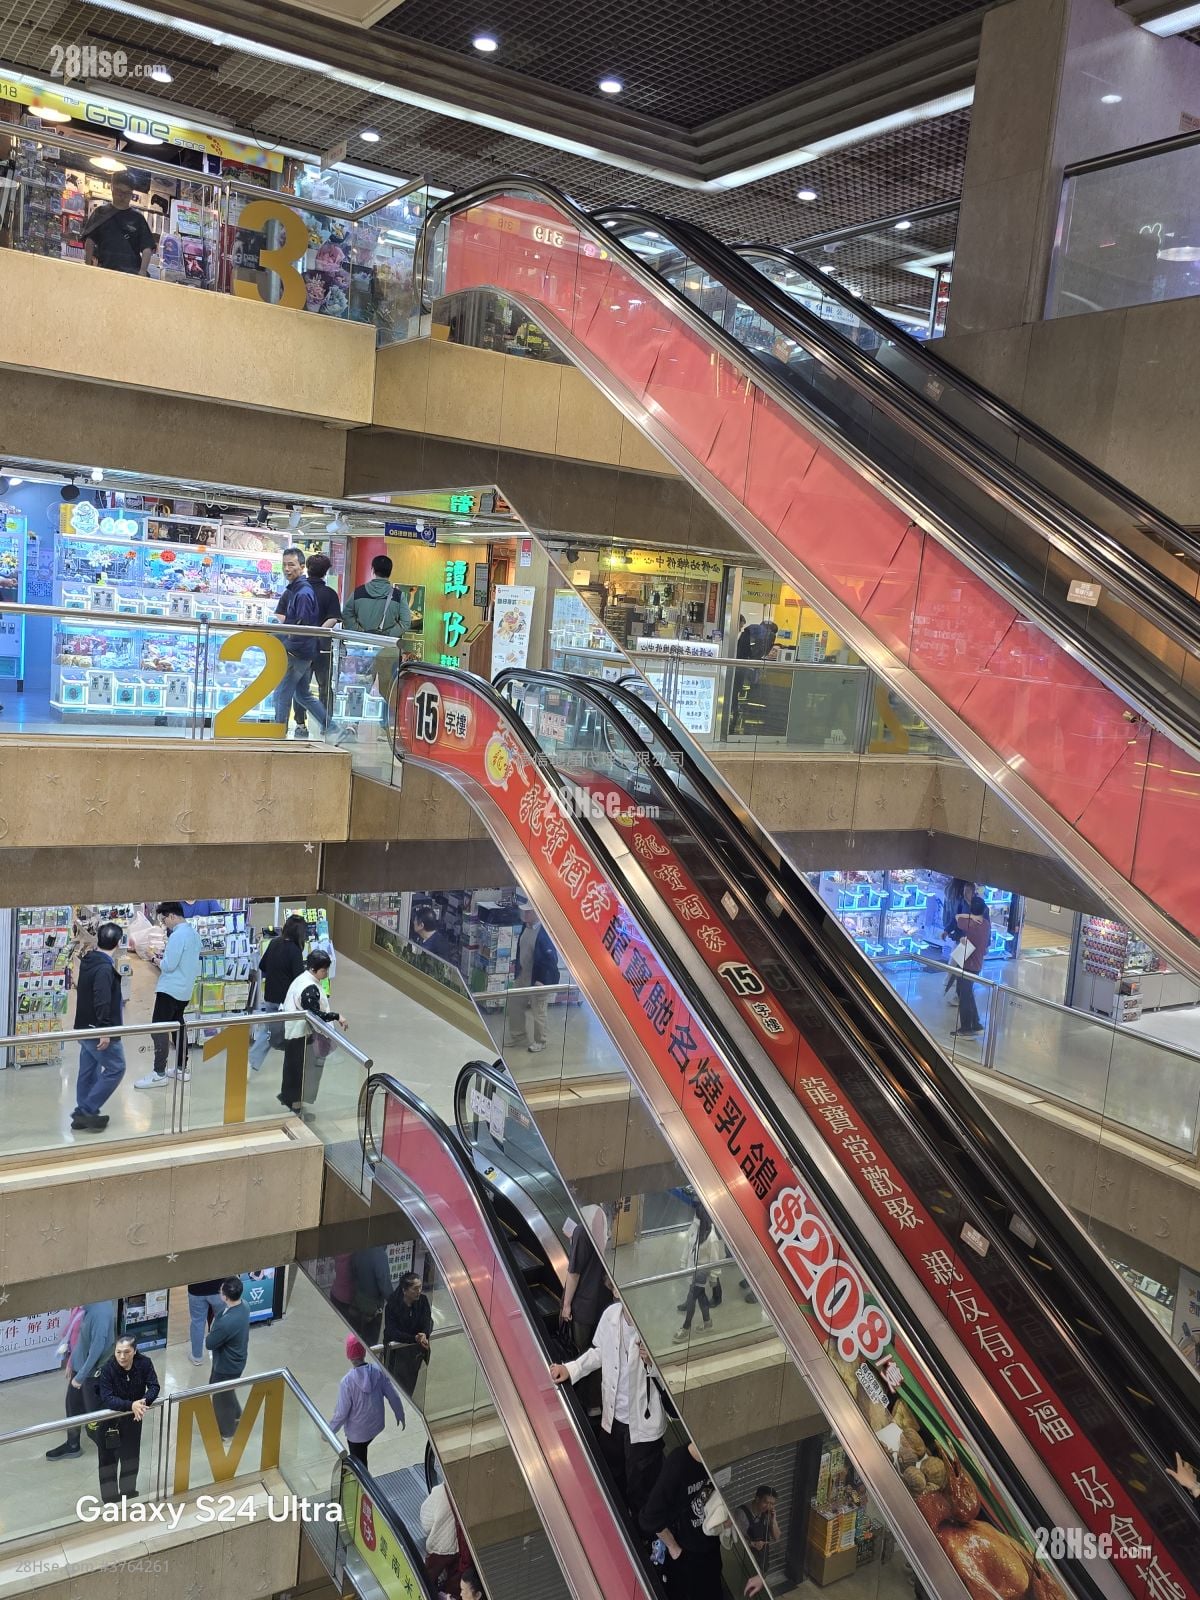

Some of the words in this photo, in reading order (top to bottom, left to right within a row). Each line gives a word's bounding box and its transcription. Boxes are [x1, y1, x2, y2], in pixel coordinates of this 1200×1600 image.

[233, 200, 310, 310] 3
[443, 559, 469, 648] 譚仔
[213, 631, 289, 739] 2
[415, 690, 439, 742] 15
[445, 711, 468, 738] 字樓
[633, 832, 727, 953] 龍寶酒家
[718, 962, 765, 996] 15
[752, 1002, 785, 1033] 字樓
[202, 1023, 250, 1124] 1
[601, 914, 778, 1201] 龍寶馳名燒乳鴿
[799, 1076, 925, 1231] 龍寶常歡聚
[920, 1249, 1074, 1445] 親友有口福
[173, 1377, 285, 1496] M
